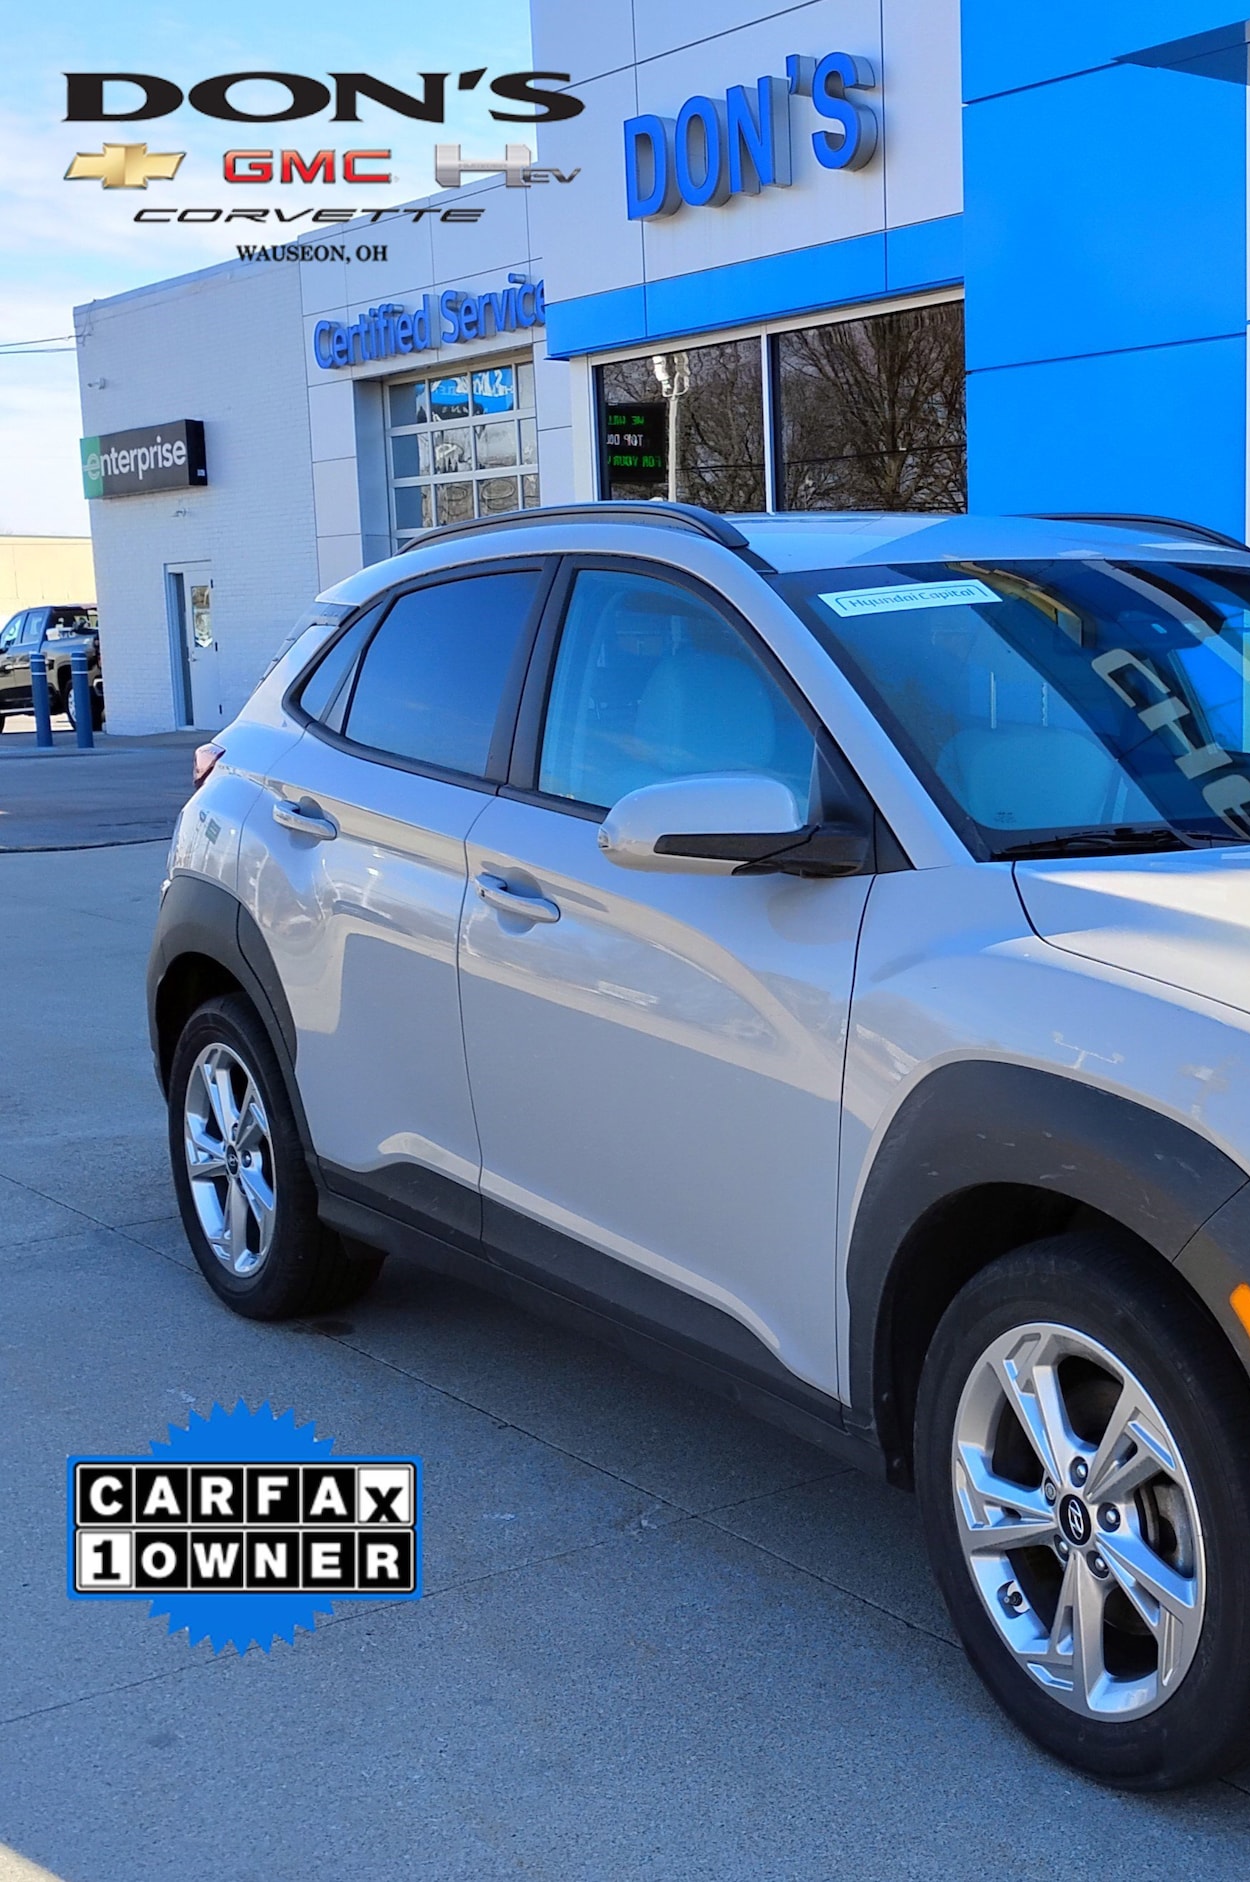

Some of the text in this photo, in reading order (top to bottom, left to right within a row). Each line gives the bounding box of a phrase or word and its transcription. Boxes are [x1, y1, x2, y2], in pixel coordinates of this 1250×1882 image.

[624, 51, 879, 221] DON'S
[314, 294, 441, 370] Certified
[82, 435, 186, 481] enterprise
[849, 587, 976, 608] Hyundai Capital
